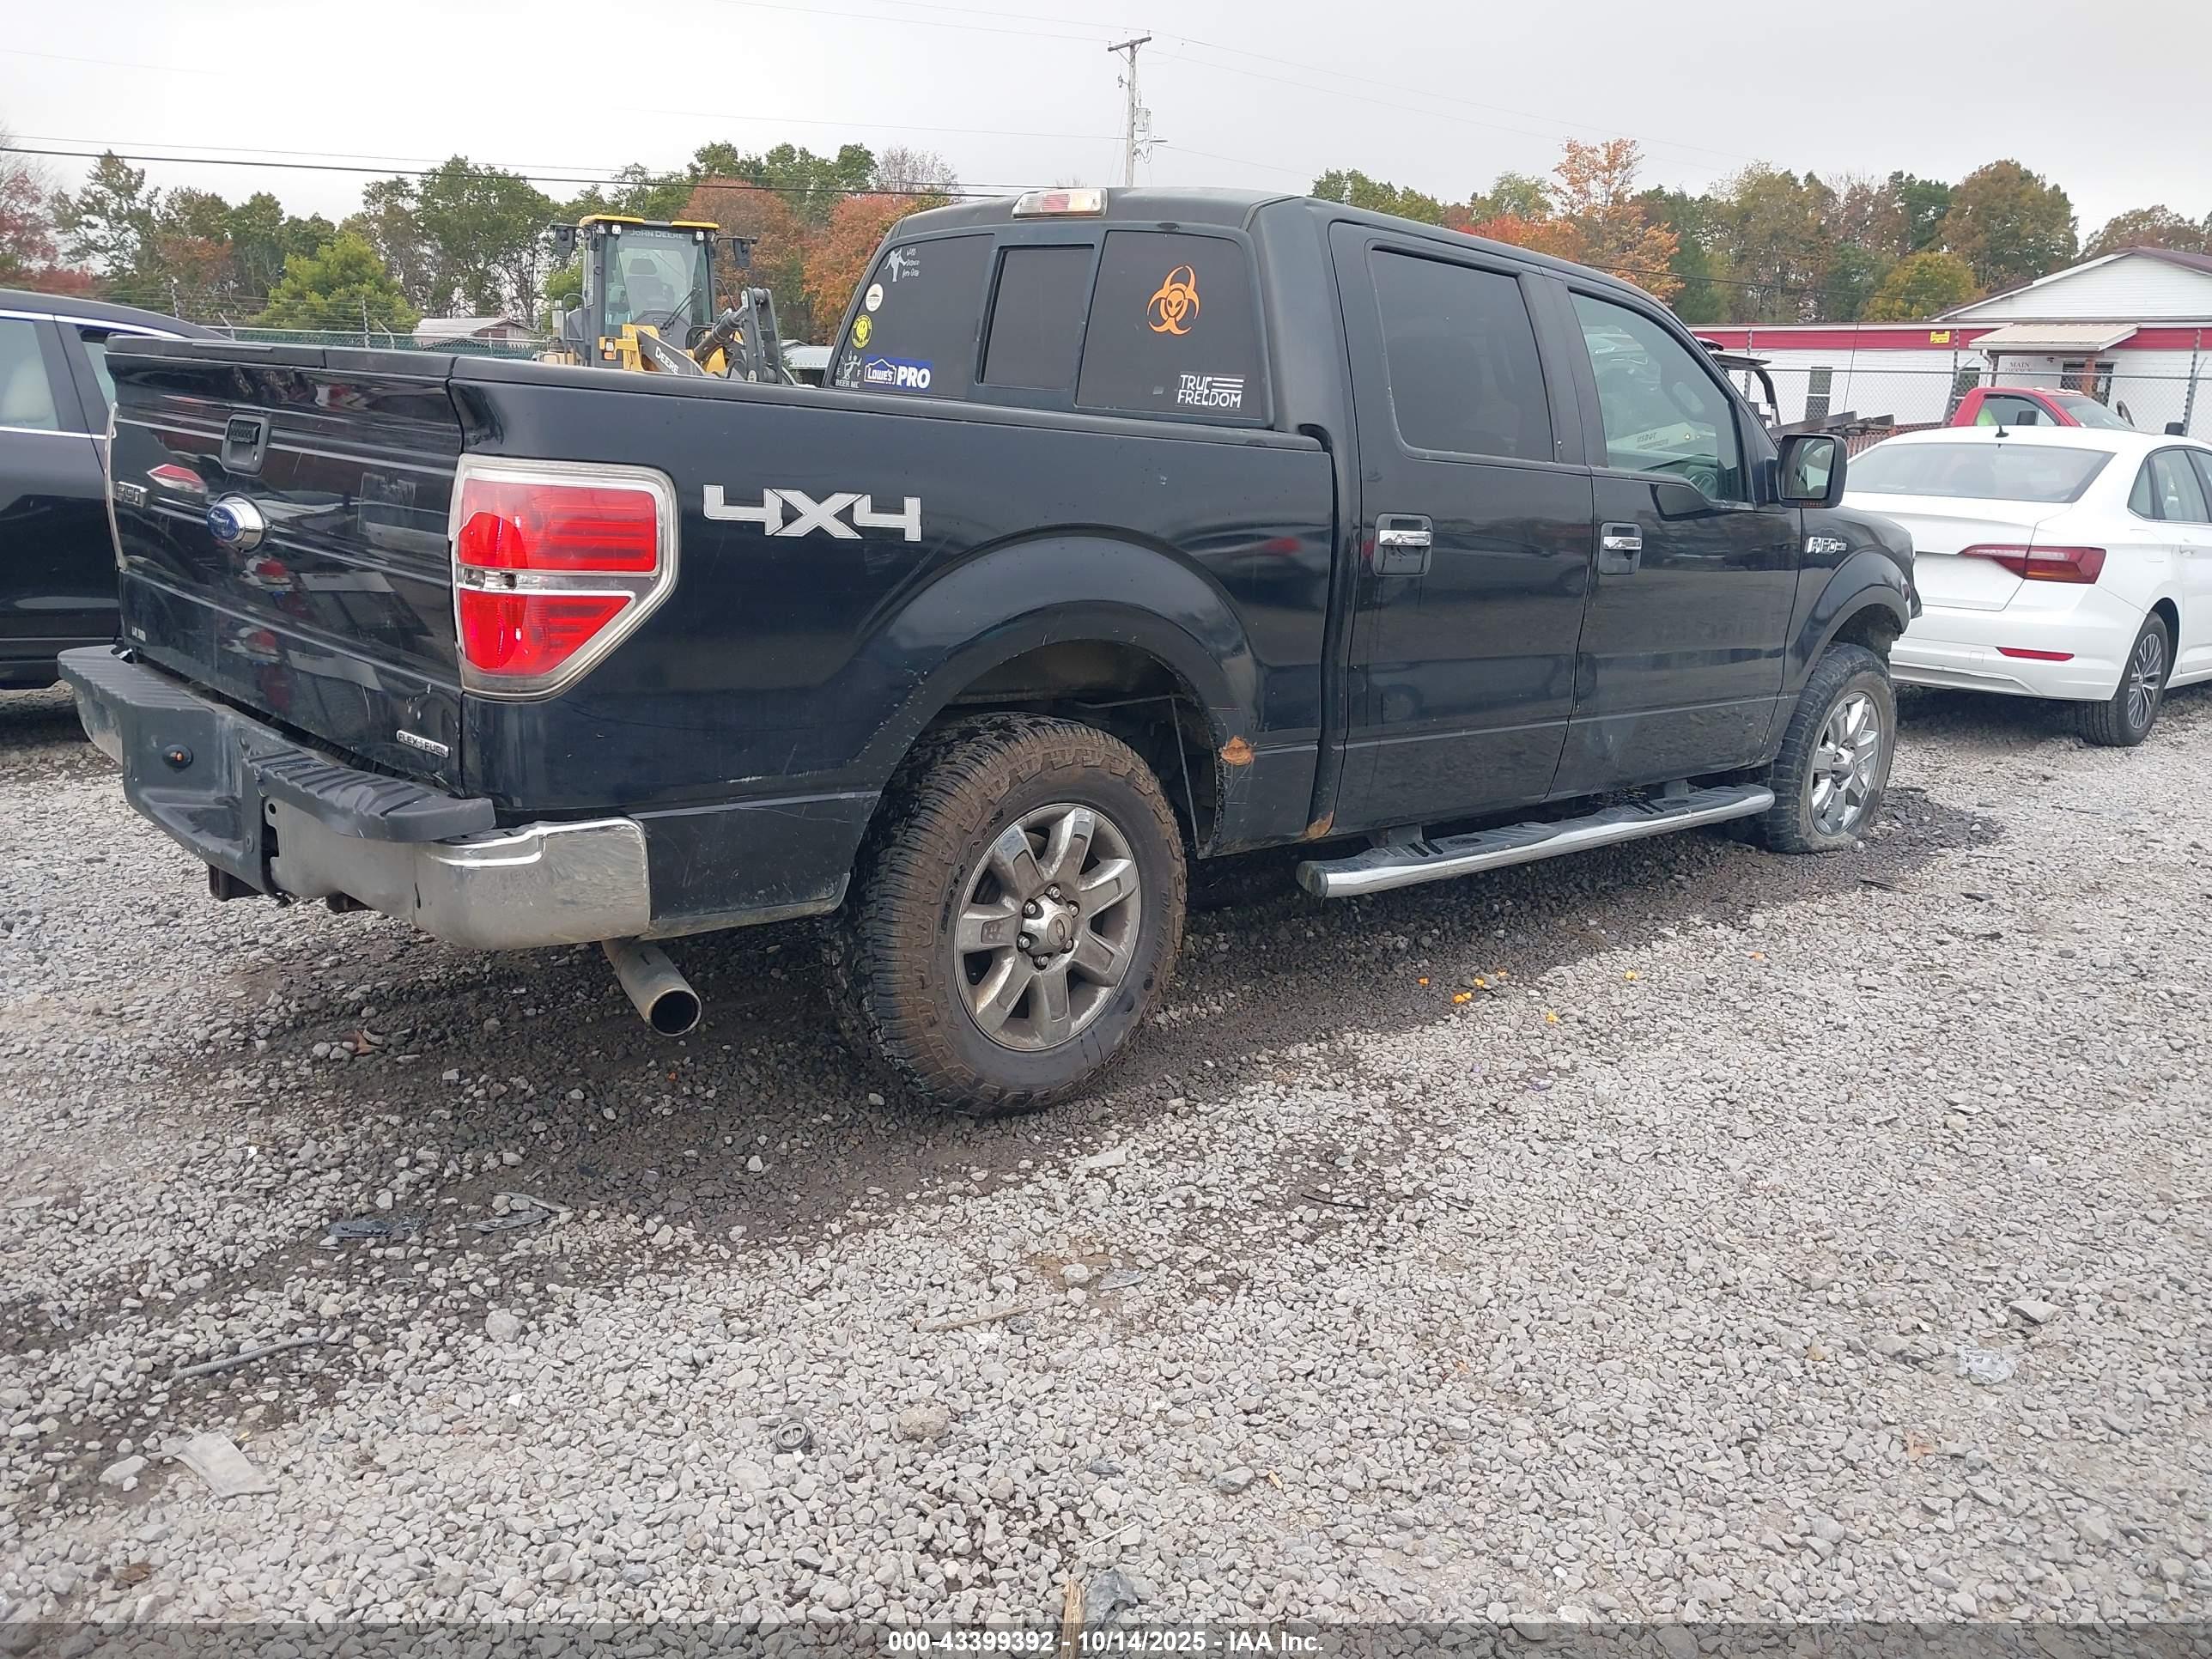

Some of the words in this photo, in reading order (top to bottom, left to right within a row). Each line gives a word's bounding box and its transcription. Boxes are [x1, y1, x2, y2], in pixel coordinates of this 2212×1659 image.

[630, 229, 653, 238] JOHN
[654, 230, 685, 240] DEERE
[655, 346, 679, 375] DEERE
[836, 379, 850, 388] BEER
[867, 367, 894, 382] LOWE'S
[896, 366, 931, 389] PRO
[1180, 374, 1212, 394] TRUE
[1176, 389, 1242, 408] FREEDOM
[398, 732, 417, 747] FLEX
[424, 741, 447, 757] FUEL
